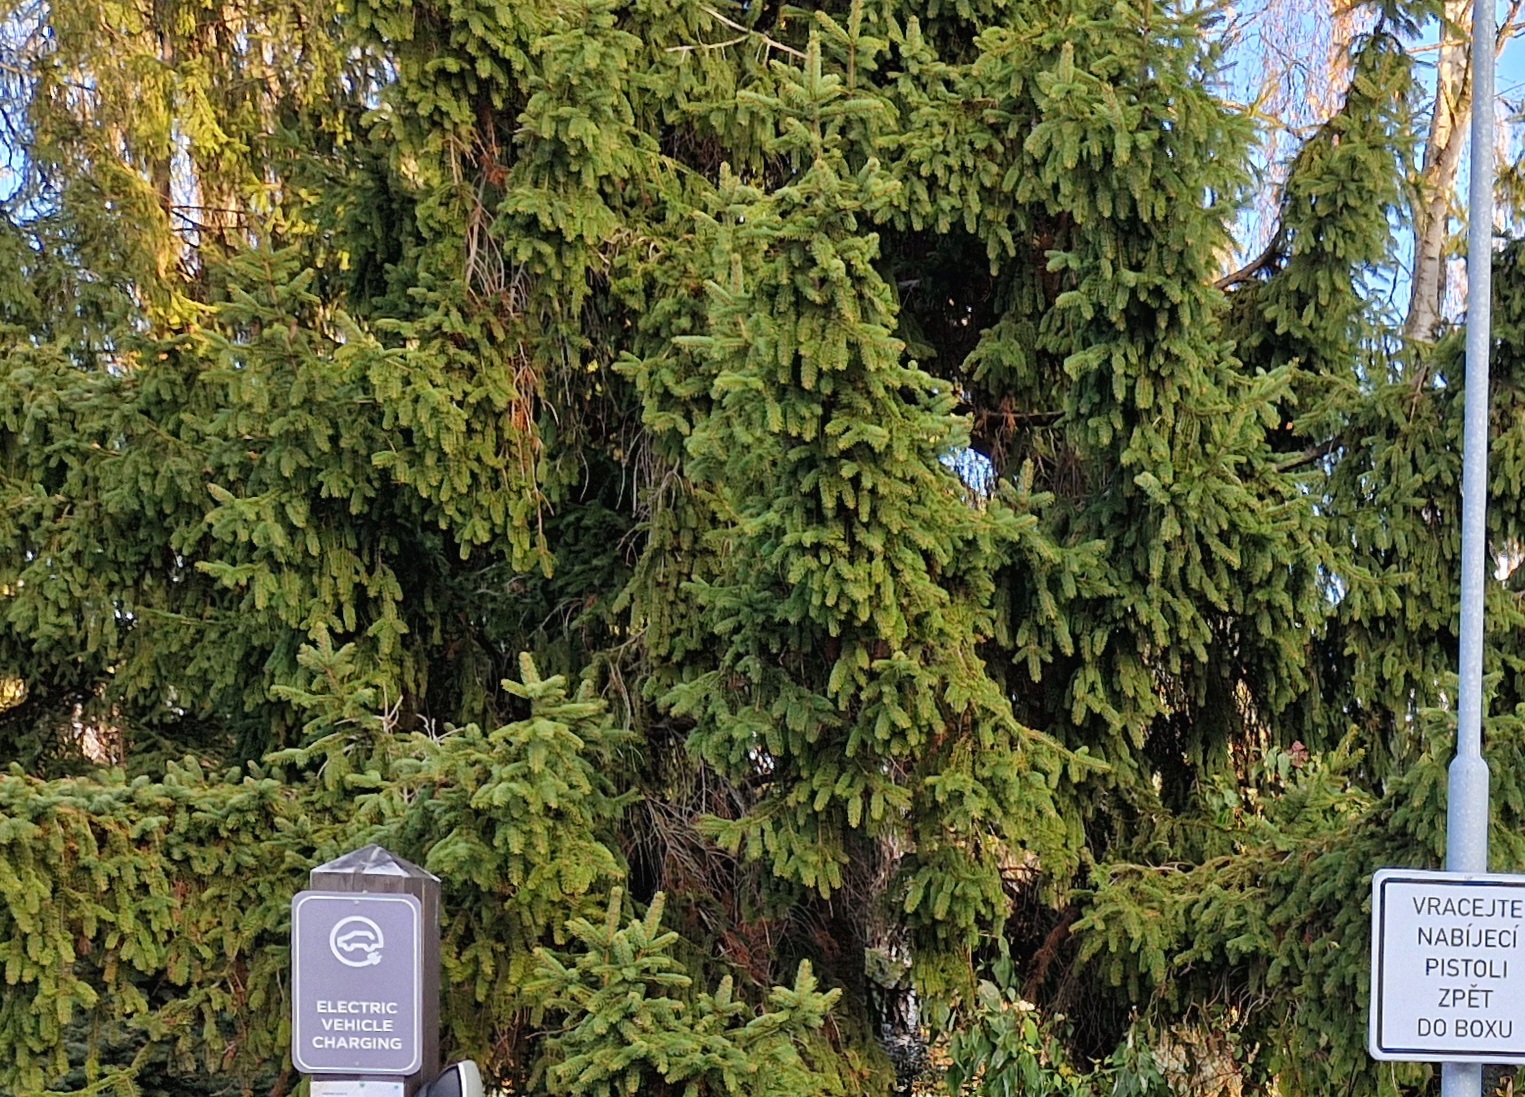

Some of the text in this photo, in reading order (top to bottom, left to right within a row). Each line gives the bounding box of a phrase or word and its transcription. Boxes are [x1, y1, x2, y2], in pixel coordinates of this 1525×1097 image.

[1412, 896, 1523, 919] VRACEJTE
[1417, 922, 1520, 949] NABÍJECÍ
[1425, 957, 1508, 979] PISTOLI
[1437, 983, 1494, 1009] ZPĚT
[316, 1000, 398, 1015] ELECTRIC
[320, 1017, 394, 1032] VEHICLE
[1417, 1017, 1513, 1039] DO BOXU
[311, 1035, 403, 1050] CHARGING
